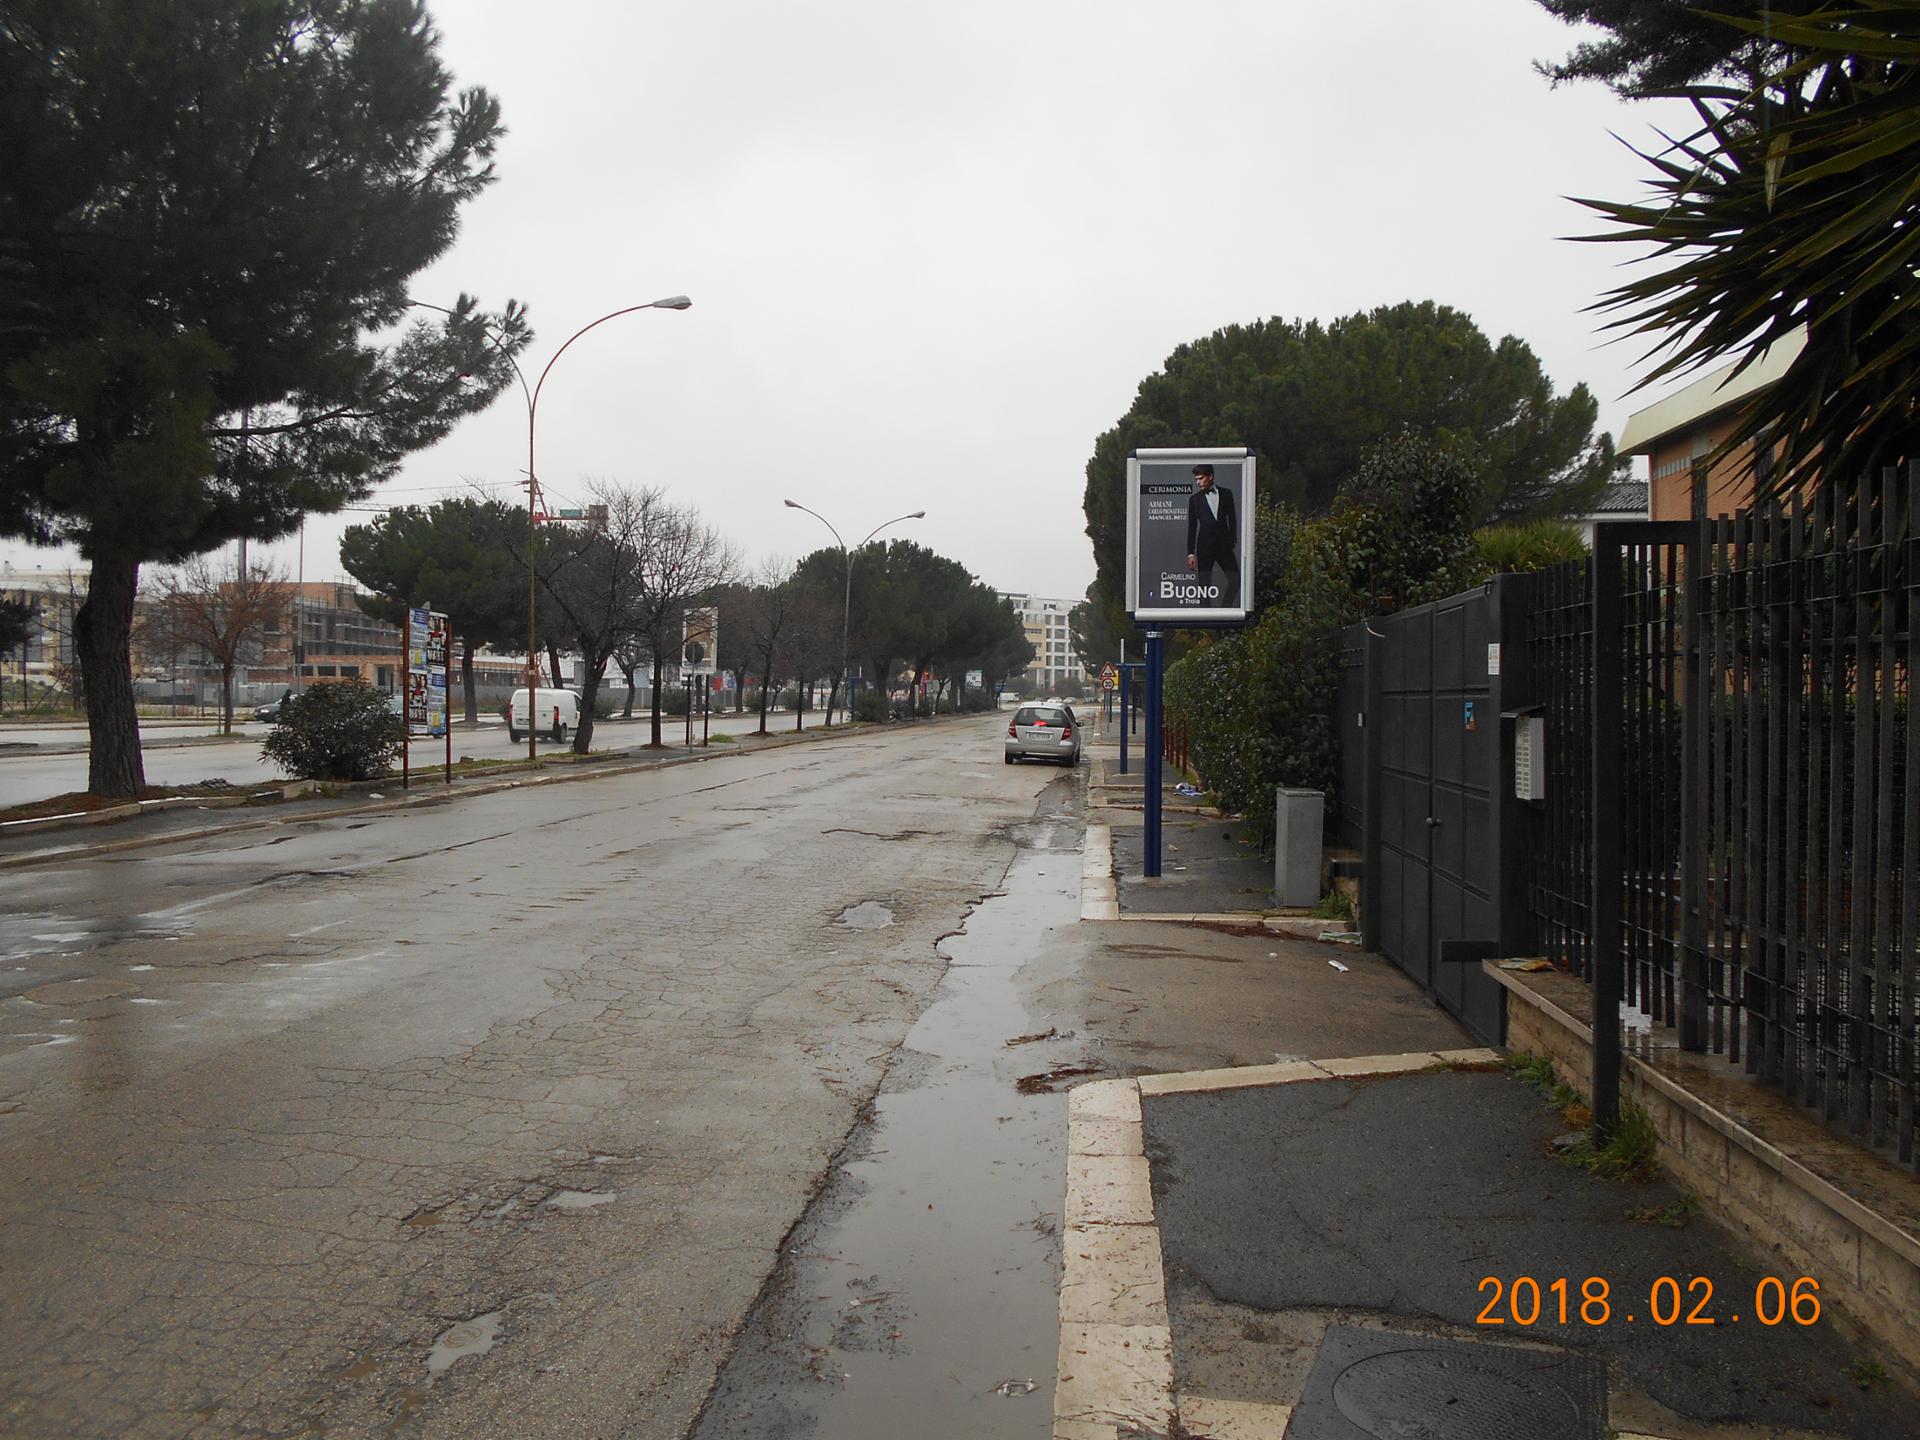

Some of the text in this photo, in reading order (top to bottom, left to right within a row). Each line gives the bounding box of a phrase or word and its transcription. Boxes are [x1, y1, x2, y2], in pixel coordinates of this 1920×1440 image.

[1148, 500, 1172, 508] ARMANI
[1160, 571, 1196, 581] CARMELINO
[1160, 581, 1219, 599] BUONO
